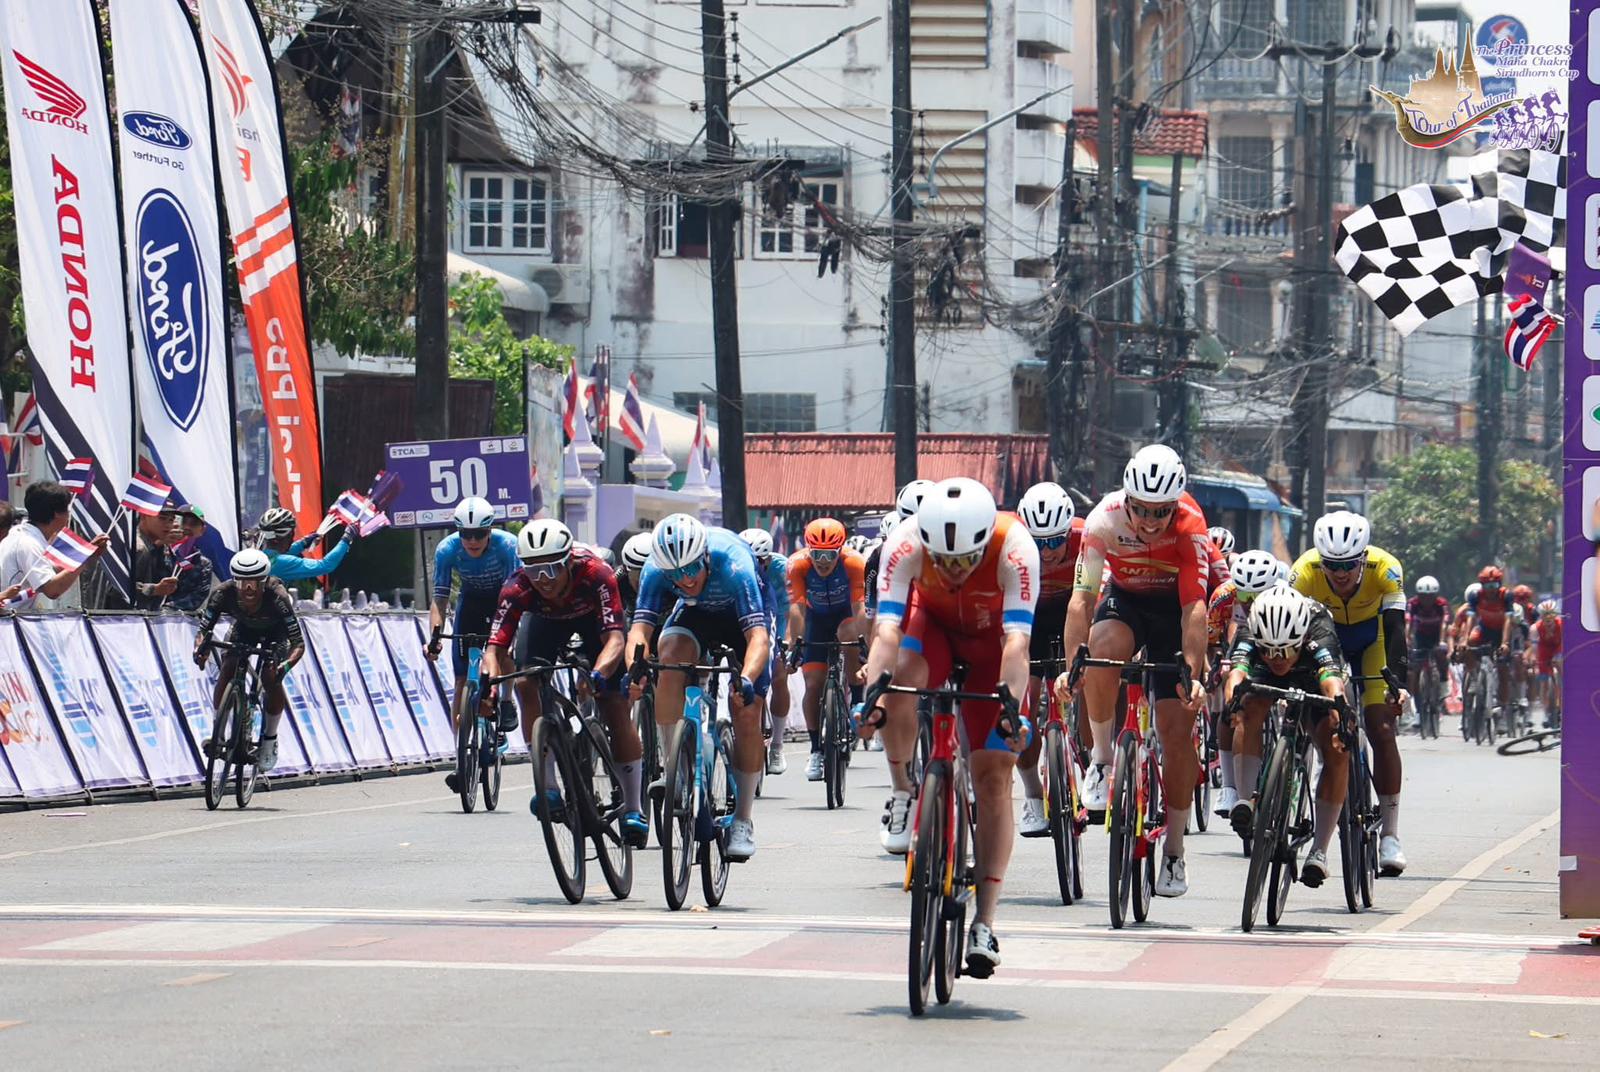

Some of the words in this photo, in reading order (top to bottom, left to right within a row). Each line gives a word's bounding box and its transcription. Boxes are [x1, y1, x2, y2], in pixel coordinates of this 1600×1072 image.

[429, 457, 488, 504] 50
[498, 488, 511, 499] M.
[490, 599, 512, 640] HELAZ
[597, 584, 616, 624] HELAZ
